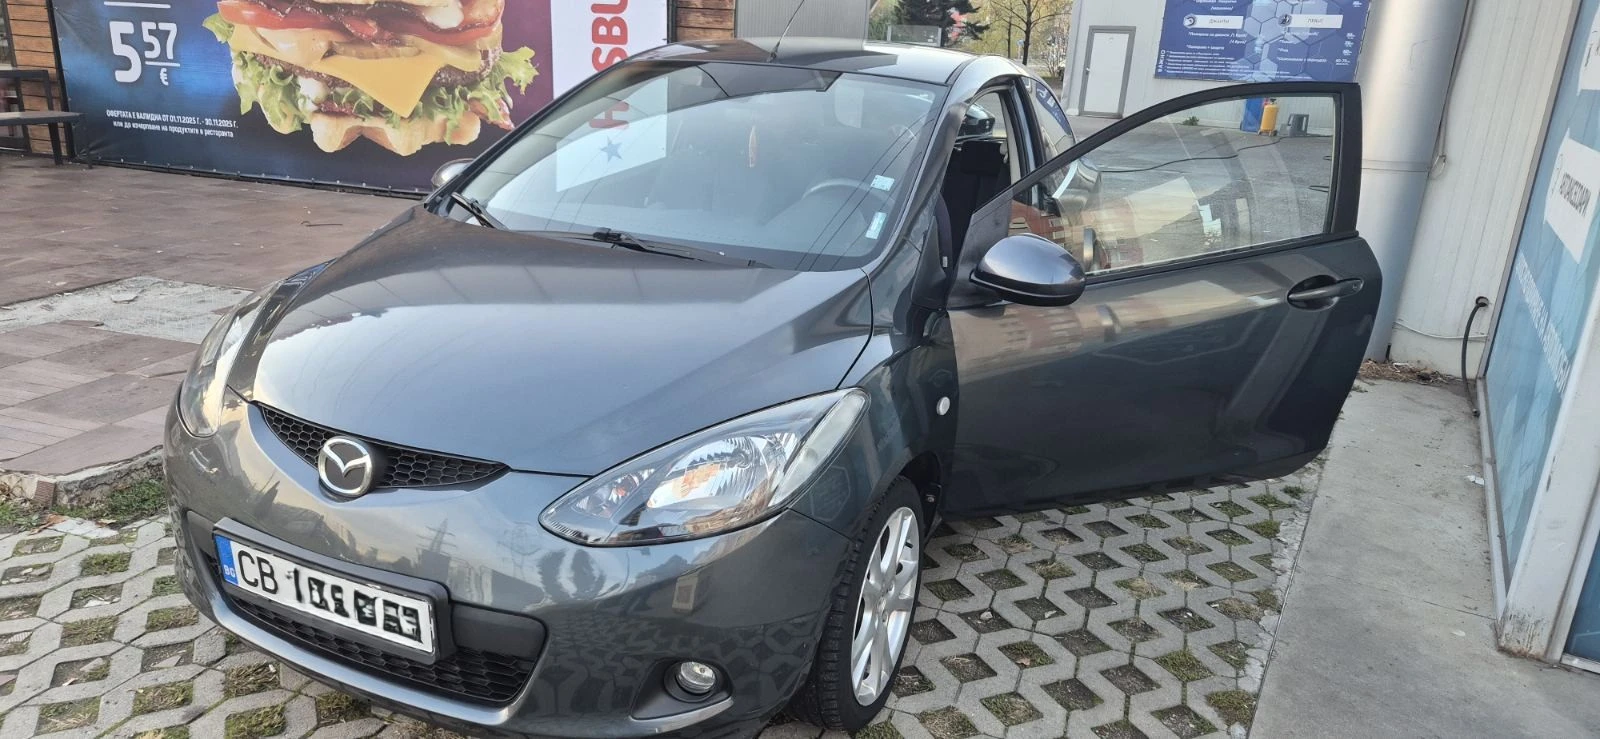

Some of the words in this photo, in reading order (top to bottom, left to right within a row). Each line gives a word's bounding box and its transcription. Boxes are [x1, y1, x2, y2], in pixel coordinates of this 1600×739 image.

[109, 21, 142, 83] 5
[141, 21, 177, 60] 57
[160, 67, 169, 86] €
[106, 109, 132, 119] ОФЕРТАТА
[136, 112, 162, 122] ВАЛИДНА
[162, 114, 169, 122] ОТ
[169, 115, 196, 124] 01.11.2025
[205, 118, 233, 127] 30.11.2025
[113, 120, 123, 128] или
[132, 122, 161, 131] изчерпване
[169, 125, 199, 135] продуктите
[204, 129, 234, 138] ресторанта
[223, 564, 236, 578] BG
